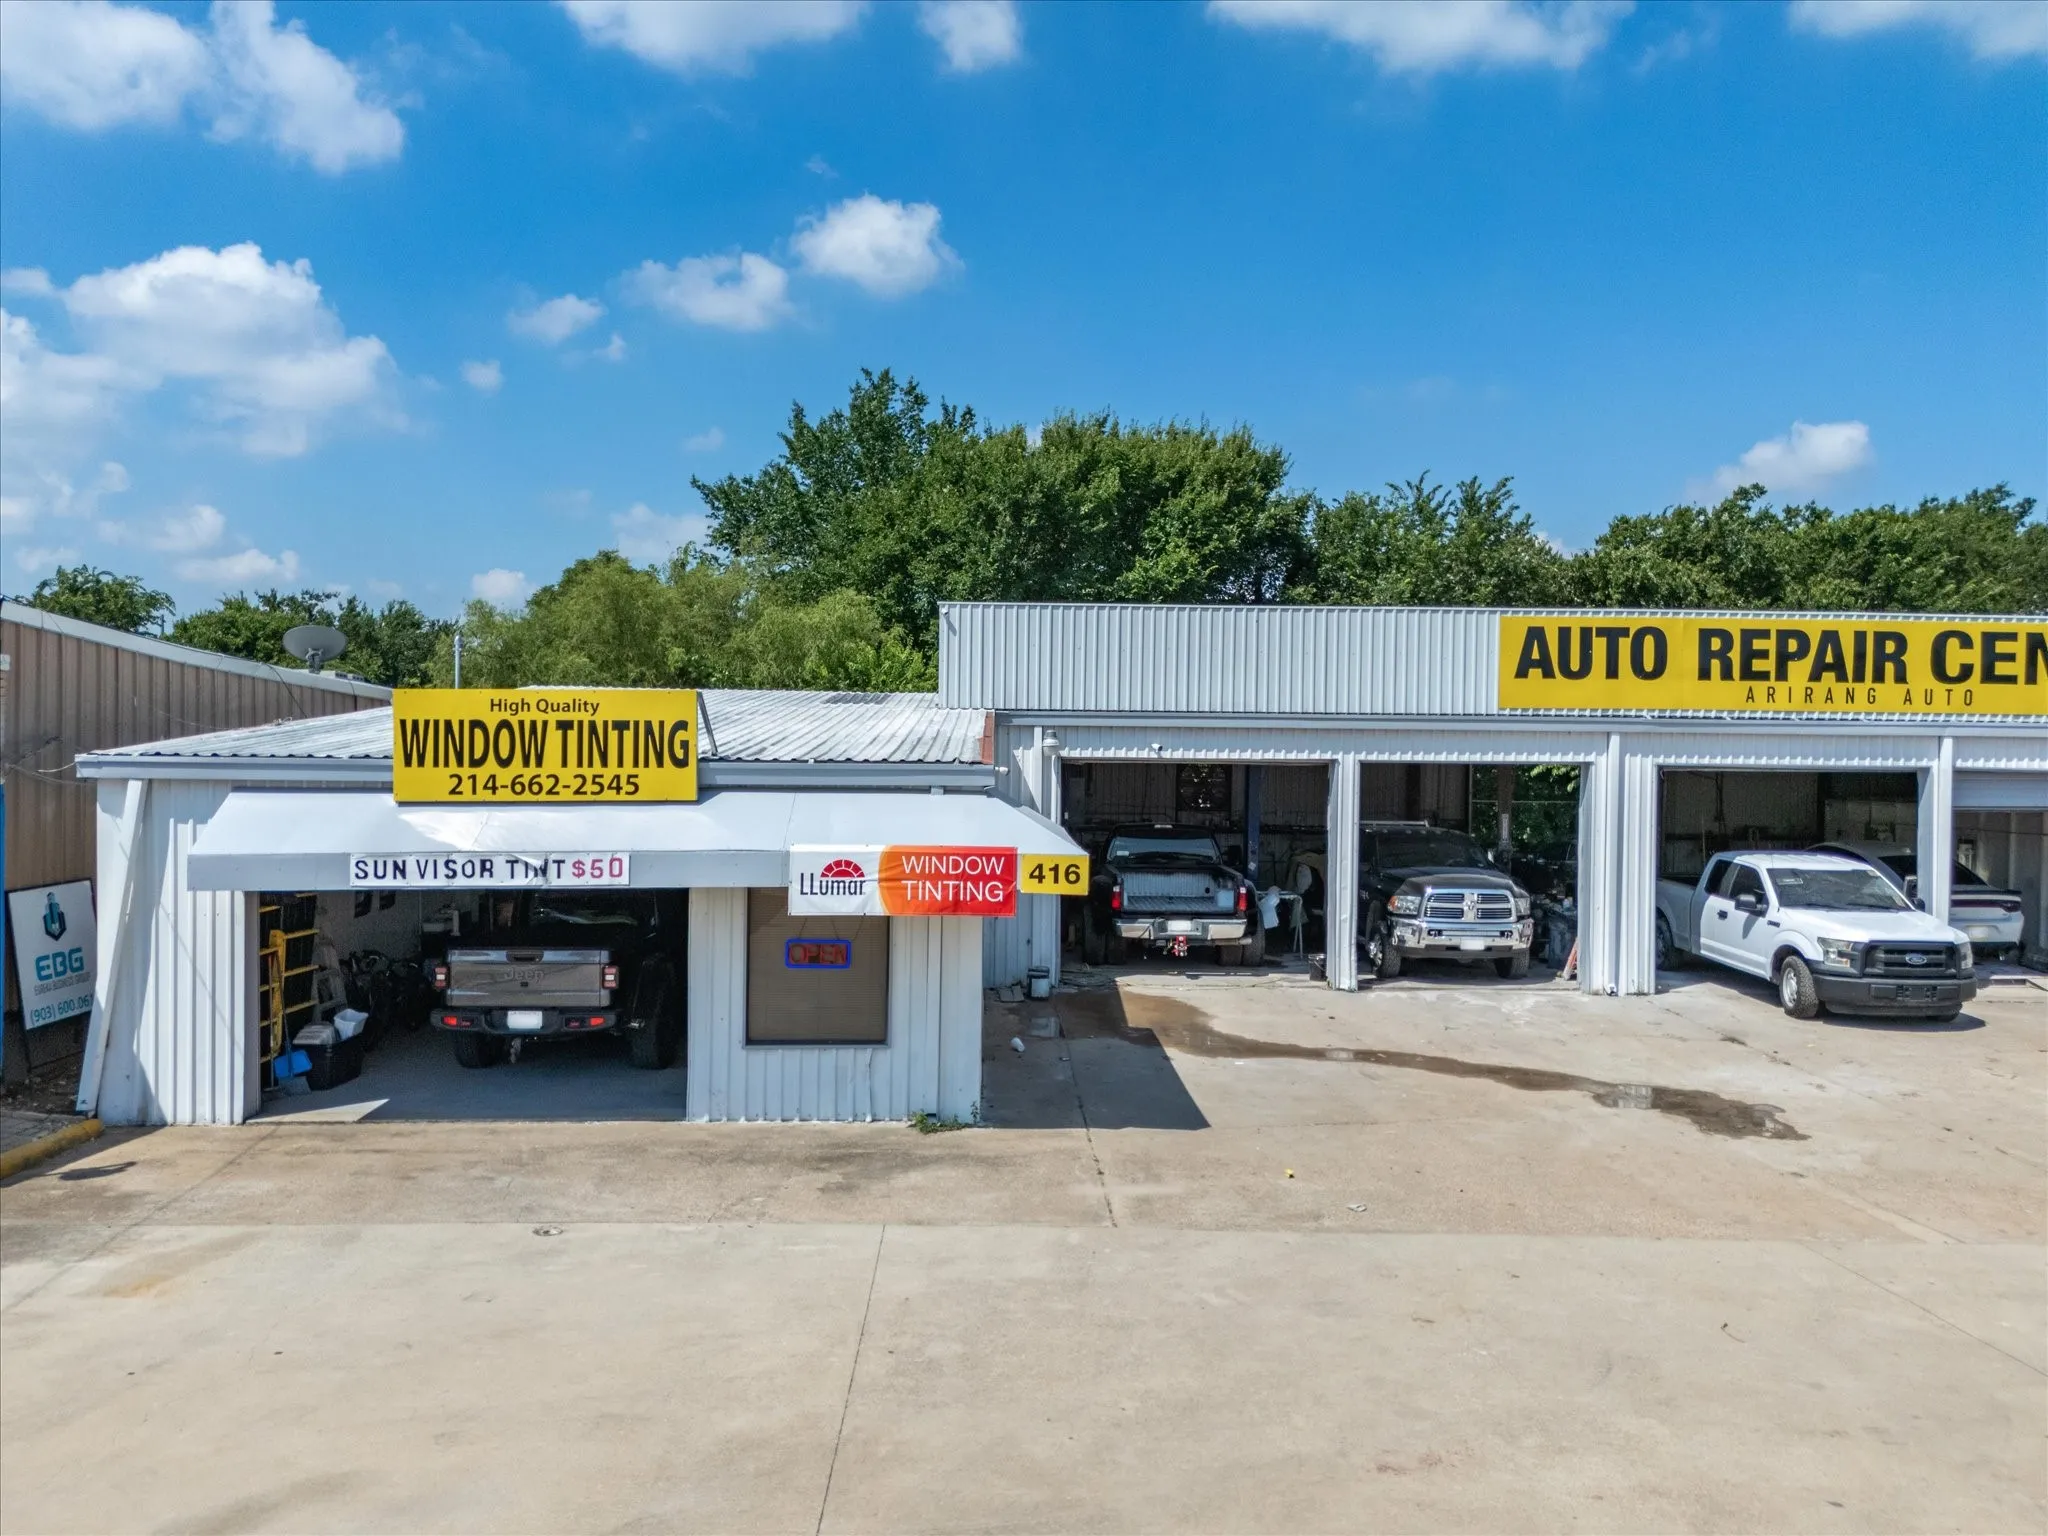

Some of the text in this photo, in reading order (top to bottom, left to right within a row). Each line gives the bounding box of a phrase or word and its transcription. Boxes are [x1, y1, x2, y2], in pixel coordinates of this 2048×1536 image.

[1514, 625, 1668, 682] AUTO
[1697, 627, 1909, 685] REPAIR
[490, 698, 600, 717] High Quality
[1745, 686, 1975, 707] ARIRANG AUTO
[399, 718, 690, 769] WINDOW TINTING
[448, 773, 640, 796] 214-662-2545
[354, 857, 624, 880] SUN VISOR TINT $50
[902, 855, 1005, 876] WINDOW
[1028, 863, 1081, 885] 416
[800, 872, 867, 896] LLumar
[901, 880, 1004, 902] TINTING
[34, 946, 85, 981] EBG
[788, 943, 848, 965] OPEN
[503, 968, 545, 983] Jeep
[30, 1003, 56, 1026] (903)
